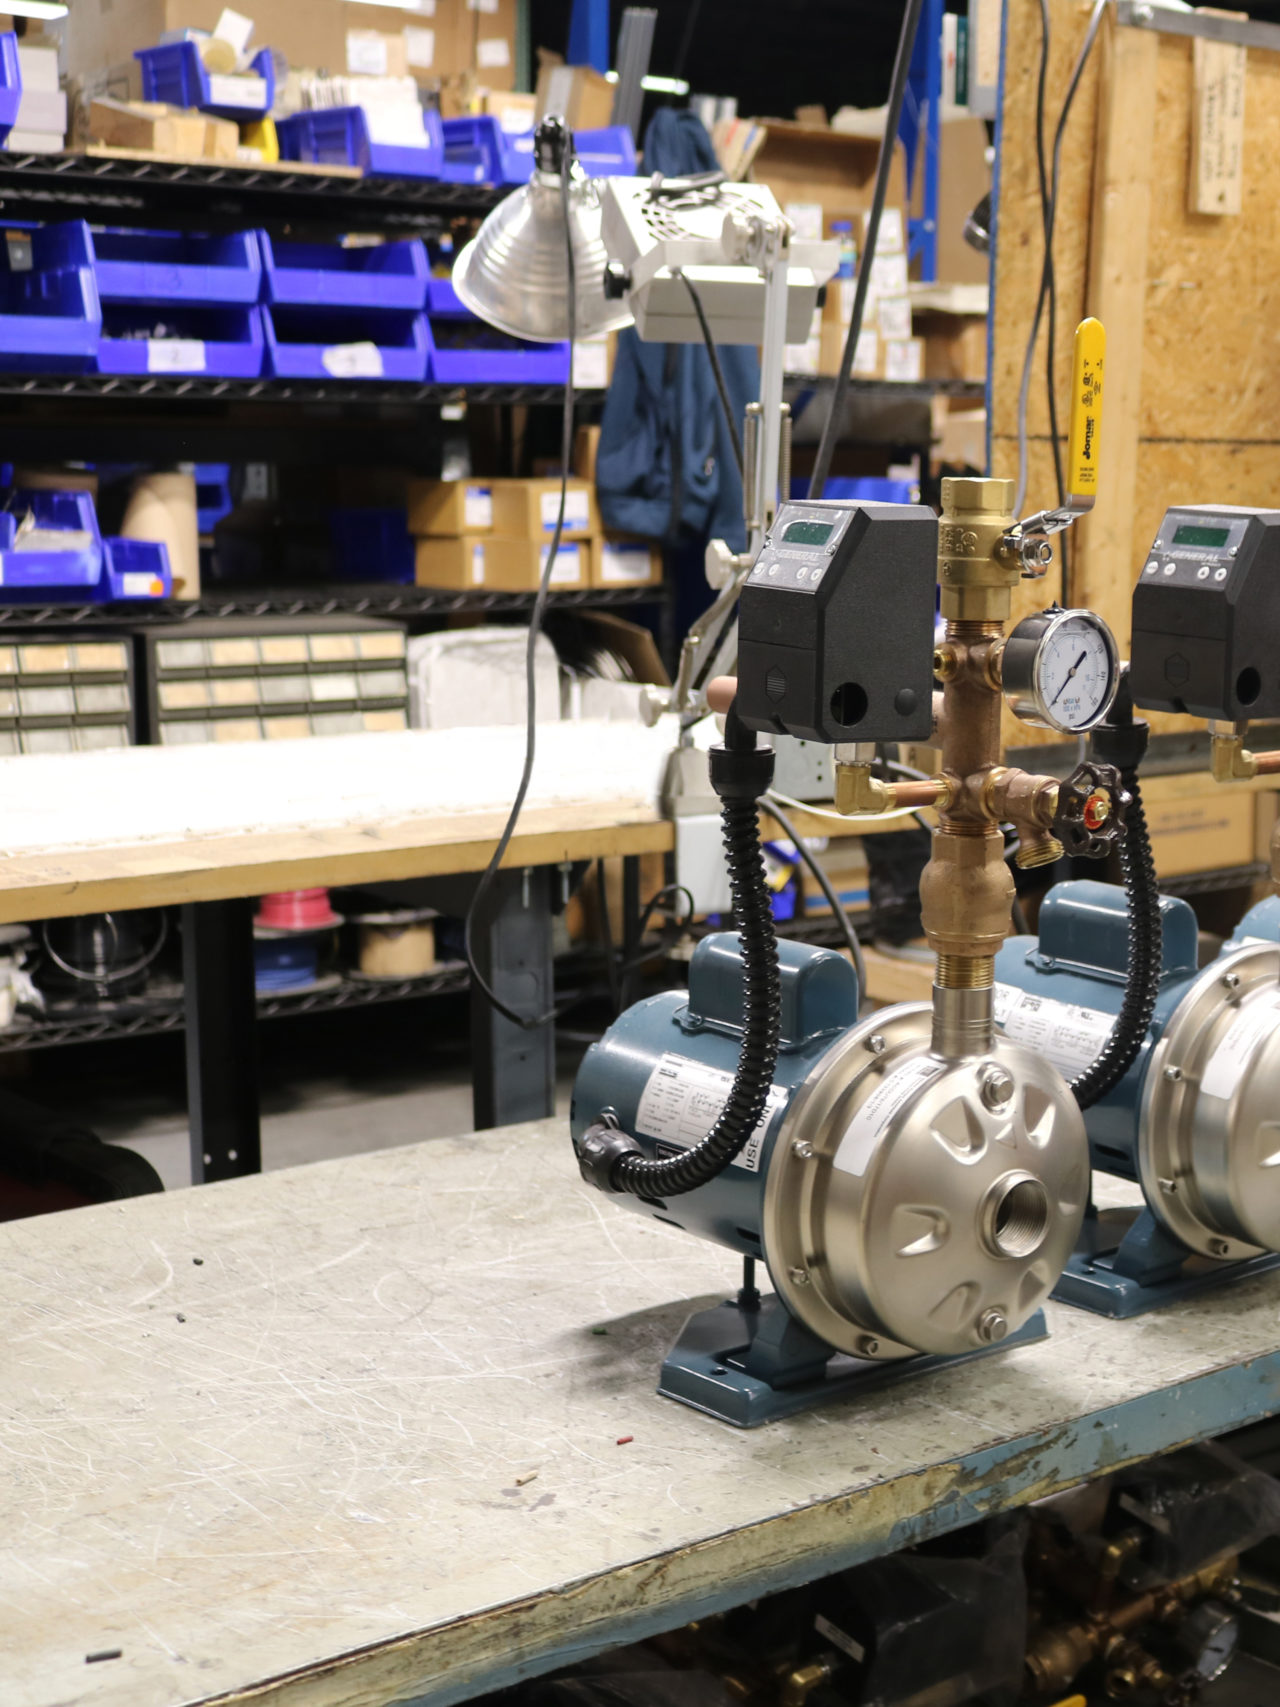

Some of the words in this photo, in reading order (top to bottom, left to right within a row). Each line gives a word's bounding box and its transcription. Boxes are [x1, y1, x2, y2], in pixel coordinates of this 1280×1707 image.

[1082, 416, 1093, 460] Jomar
[1171, 550, 1218, 562] GENERAL
[745, 1138, 760, 1169] USE
